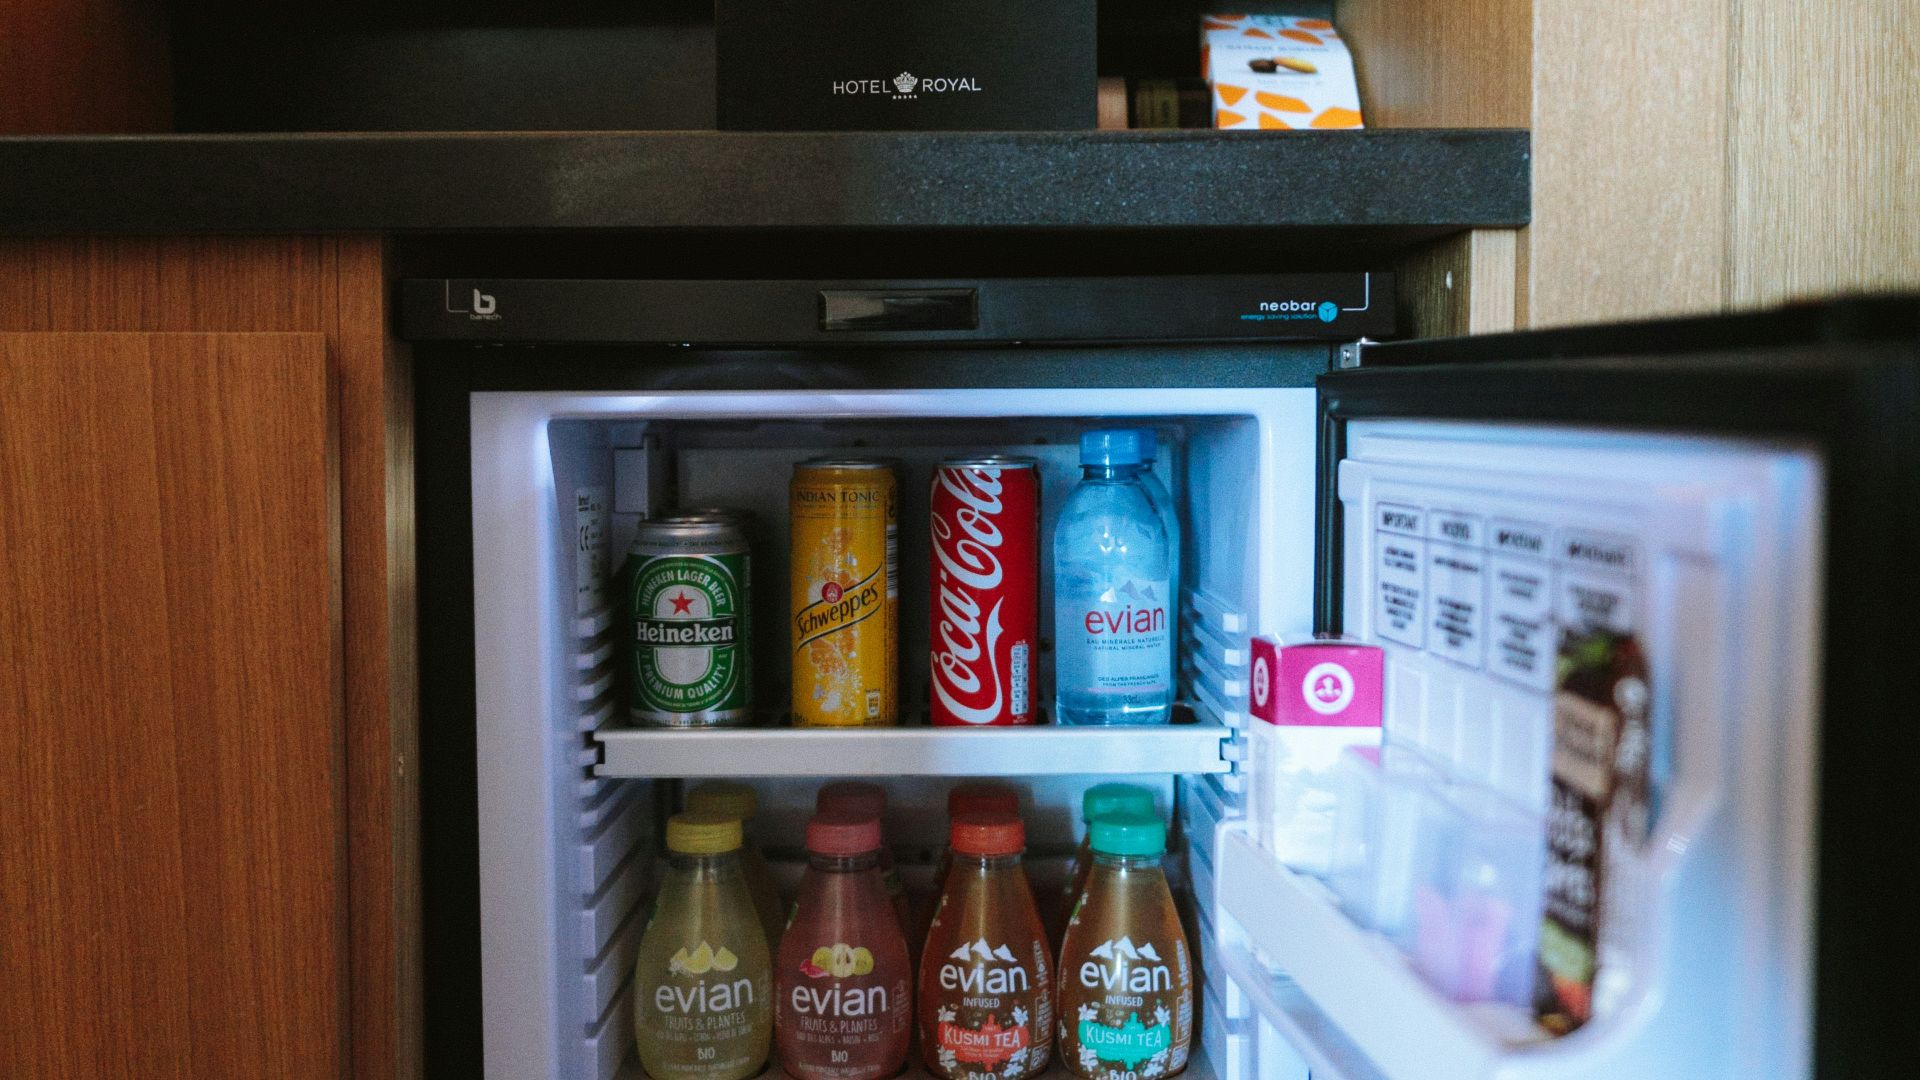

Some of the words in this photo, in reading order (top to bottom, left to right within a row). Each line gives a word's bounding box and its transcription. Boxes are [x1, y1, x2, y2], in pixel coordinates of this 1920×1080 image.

[833, 80, 891, 94] HOTEL
[922, 77, 982, 92] ROYAL
[1260, 300, 1317, 311] neobar
[840, 490, 880, 502] TONIC
[677, 569, 711, 587] LAGER
[708, 581, 726, 607] BEER
[798, 582, 879, 639] Schweppes
[1084, 605, 1165, 635] evian
[637, 622, 733, 643] Heineken
[643, 664, 684, 700] PREMIUM
[687, 663, 726, 698] QUALITY
[940, 961, 1027, 993] evian
[1080, 961, 1170, 992] evian
[655, 978, 753, 1013] evian
[792, 983, 886, 1016] evian
[963, 996, 1000, 1008] INFUSED
[1105, 995, 1143, 1006] INFUSED
[707, 1012, 746, 1030] PLANTES
[801, 1016, 828, 1033] FRUITS
[829, 1020, 838, 1033] &
[841, 1018, 878, 1033] PLANTES
[944, 1025, 989, 1045] KUSMI
[994, 1028, 1020, 1047] TEA
[1085, 1024, 1132, 1045] KUSMI
[1137, 1028, 1162, 1046] TEA
[698, 1047, 715, 1060] BIO
[831, 1050, 848, 1063] BIO
